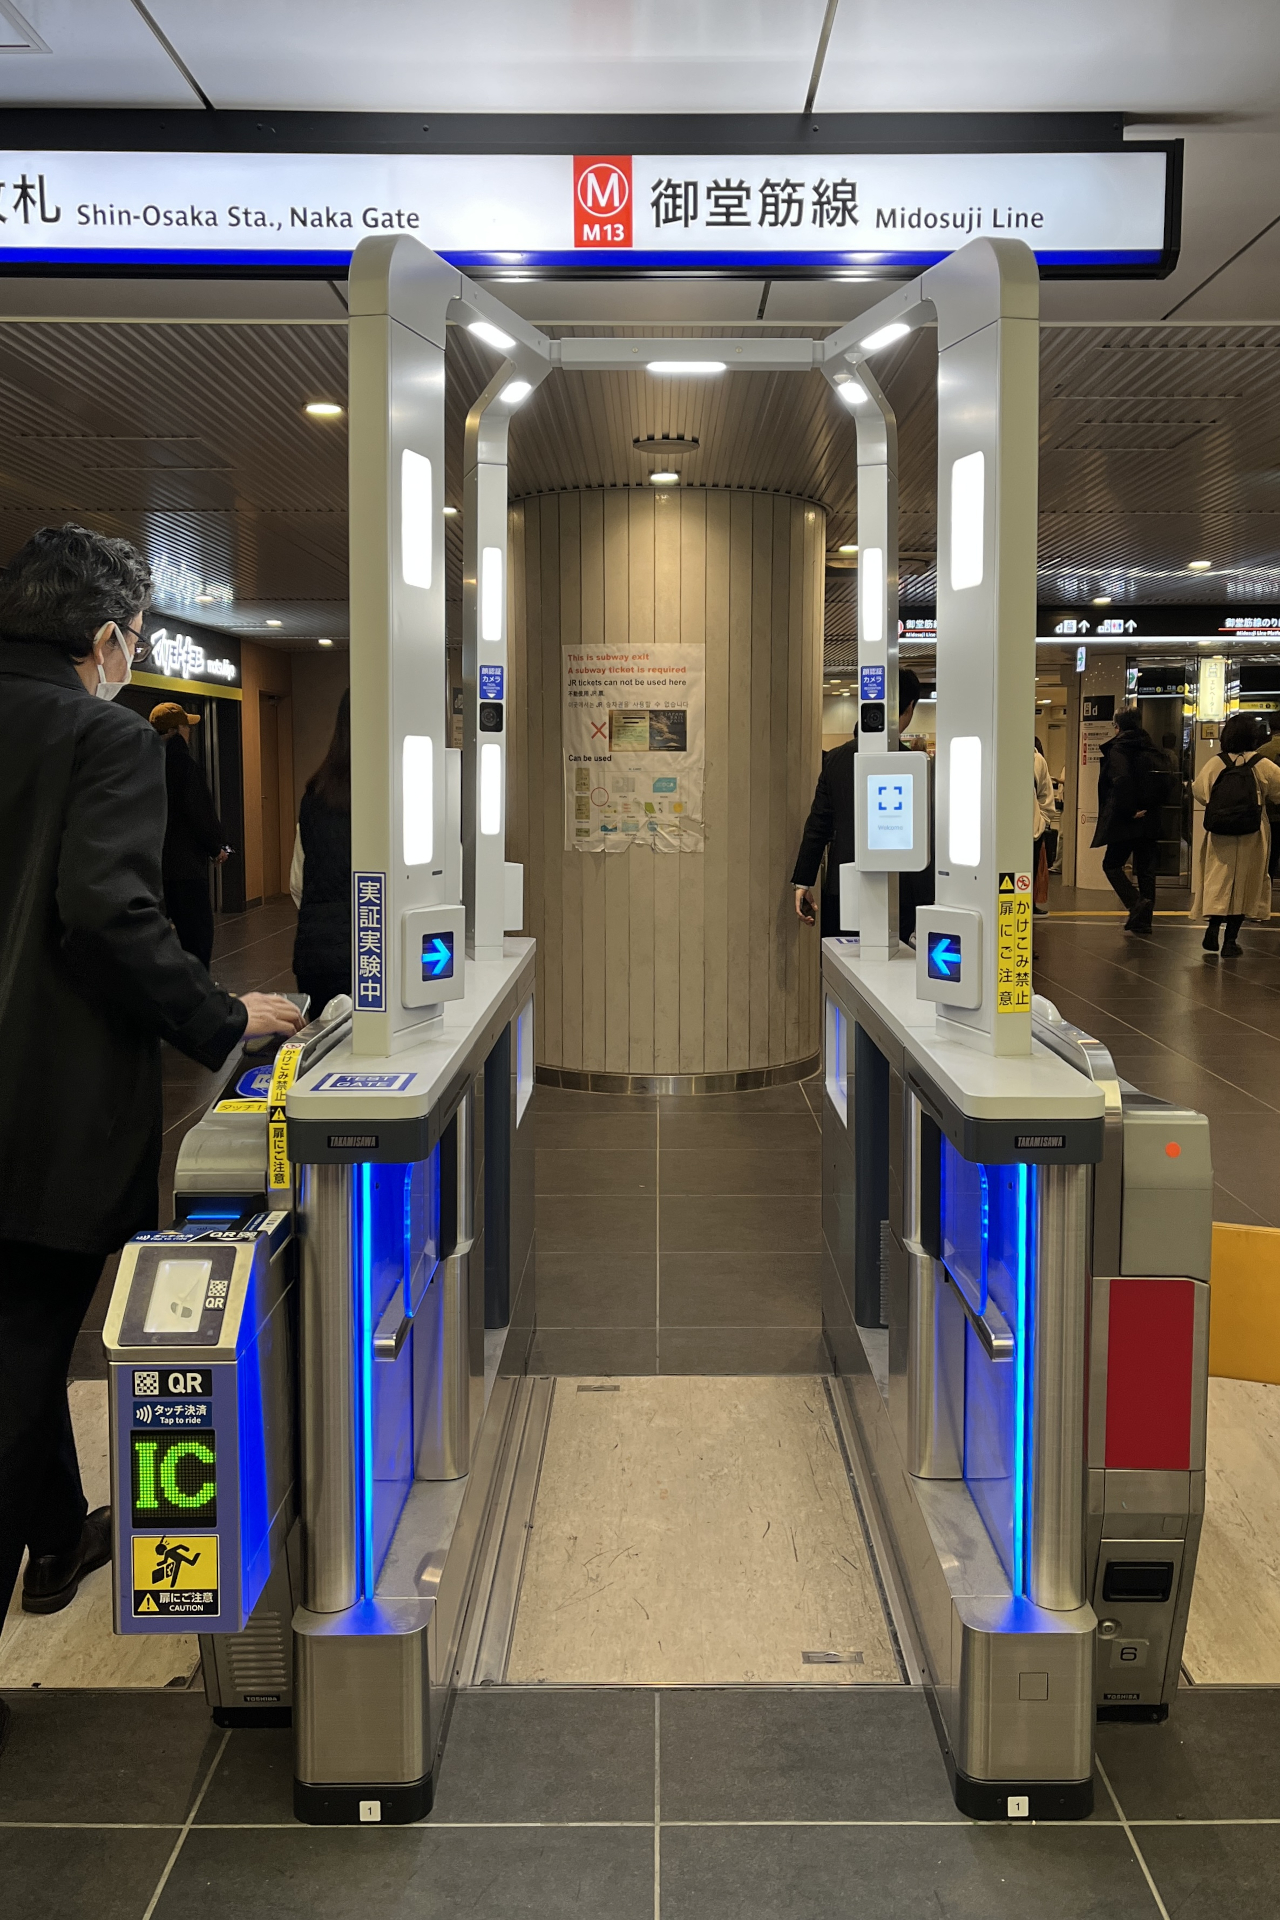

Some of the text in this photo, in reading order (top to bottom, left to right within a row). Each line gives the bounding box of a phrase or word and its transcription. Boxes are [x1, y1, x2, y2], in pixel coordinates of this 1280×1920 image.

[0, 173, 61, 225] 札
[650, 178, 860, 229] 御堂筋線
[77, 203, 420, 231] Shin-Osaka Sta., Naka Gate
[875, 207, 1044, 234] Midosuji Line
[582, 223, 626, 242] M13
[1225, 618, 1280, 628] 御堂筋線のり
[568, 654, 584, 662] This
[596, 653, 629, 663] subway
[575, 667, 606, 675] subway
[648, 666, 686, 674] required
[358, 881, 381, 1002] 実証実験中
[998, 900, 1014, 1007] 扉にご注意
[1015, 900, 1030, 1006] かけこみ禁止
[274, 1050, 296, 1102] かけこみ禁止
[330, 1136, 376, 1147] TAKAMISAWA
[1017, 1136, 1063, 1148] TAKAMISAWA
[272, 1126, 286, 1185] 扉にご注意
[206, 1297, 224, 1309] QR
[168, 1372, 203, 1394] QR
[154, 1404, 207, 1416] タッチ決済
[160, 1416, 202, 1425] Tap to ride
[134, 1441, 217, 1509] IC
[159, 1592, 214, 1604] 扉にご注意
[169, 1604, 204, 1612] CAUTION
[1120, 1646, 1137, 1662] 6
